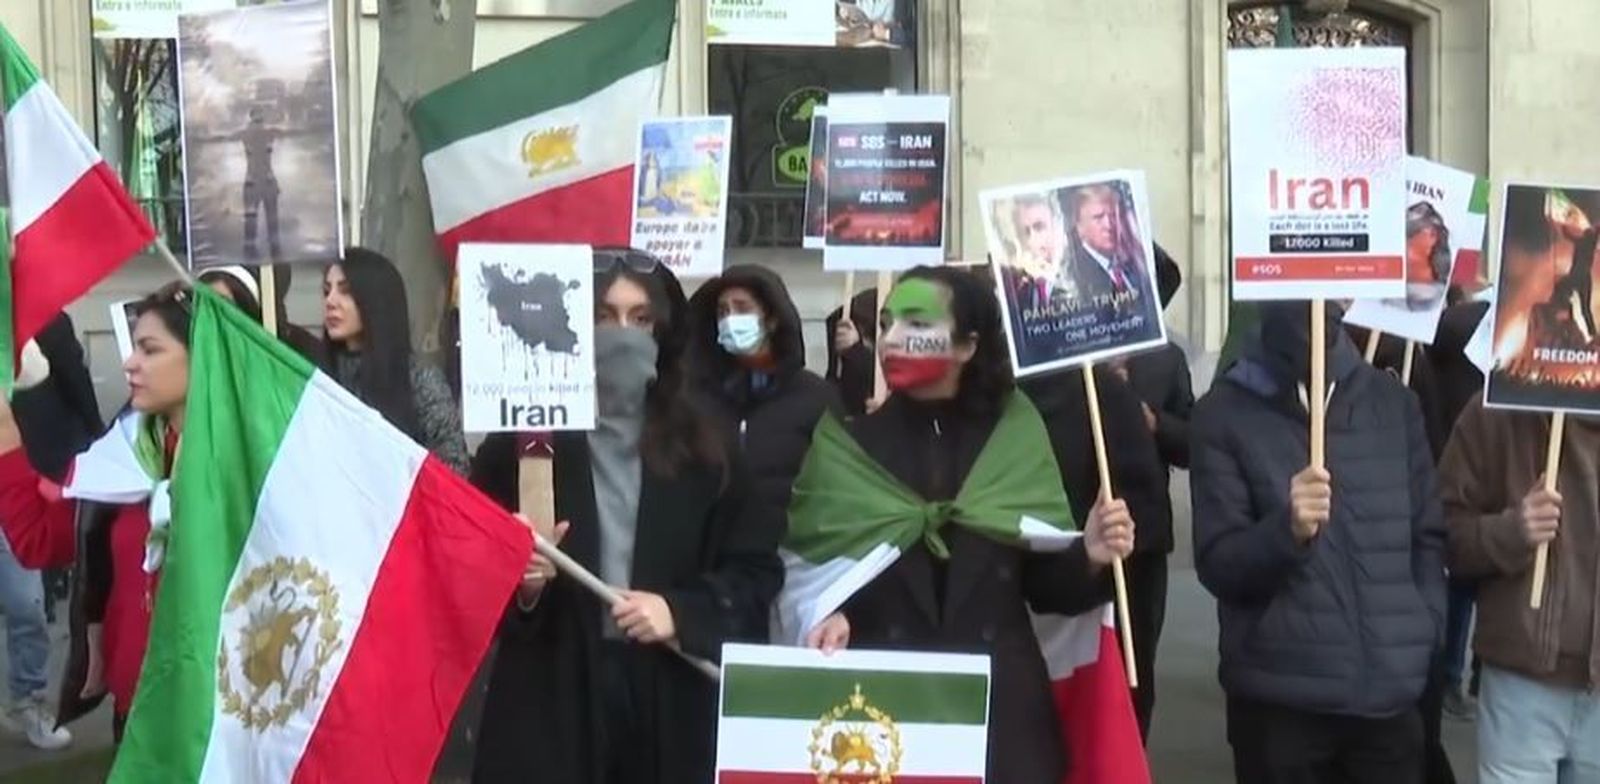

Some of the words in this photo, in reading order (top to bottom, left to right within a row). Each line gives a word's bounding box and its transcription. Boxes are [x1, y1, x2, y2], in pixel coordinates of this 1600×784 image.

[900, 135, 932, 148] IRAN
[859, 191, 879, 203] ACT
[1269, 169, 1369, 210] Iran
[1412, 181, 1445, 201] IRAN
[1269, 221, 1292, 231] Each
[1295, 221, 1311, 230] dot
[1314, 221, 1322, 230] is
[1331, 221, 1350, 230] lost
[1323, 237, 1354, 248] Killed
[521, 302, 542, 311] Iran
[1023, 299, 1080, 323] PAHLAVI
[1093, 289, 1139, 310] TRUMP
[1026, 322, 1050, 337] TWO
[1052, 313, 1098, 332] LEADERS
[1065, 327, 1088, 342] ONE
[1090, 315, 1144, 337] MOVEMENT
[906, 335, 947, 353] IRAN
[1532, 348, 1598, 364] FREEDOM
[549, 382, 580, 393] killed
[500, 398, 567, 426] Iran
